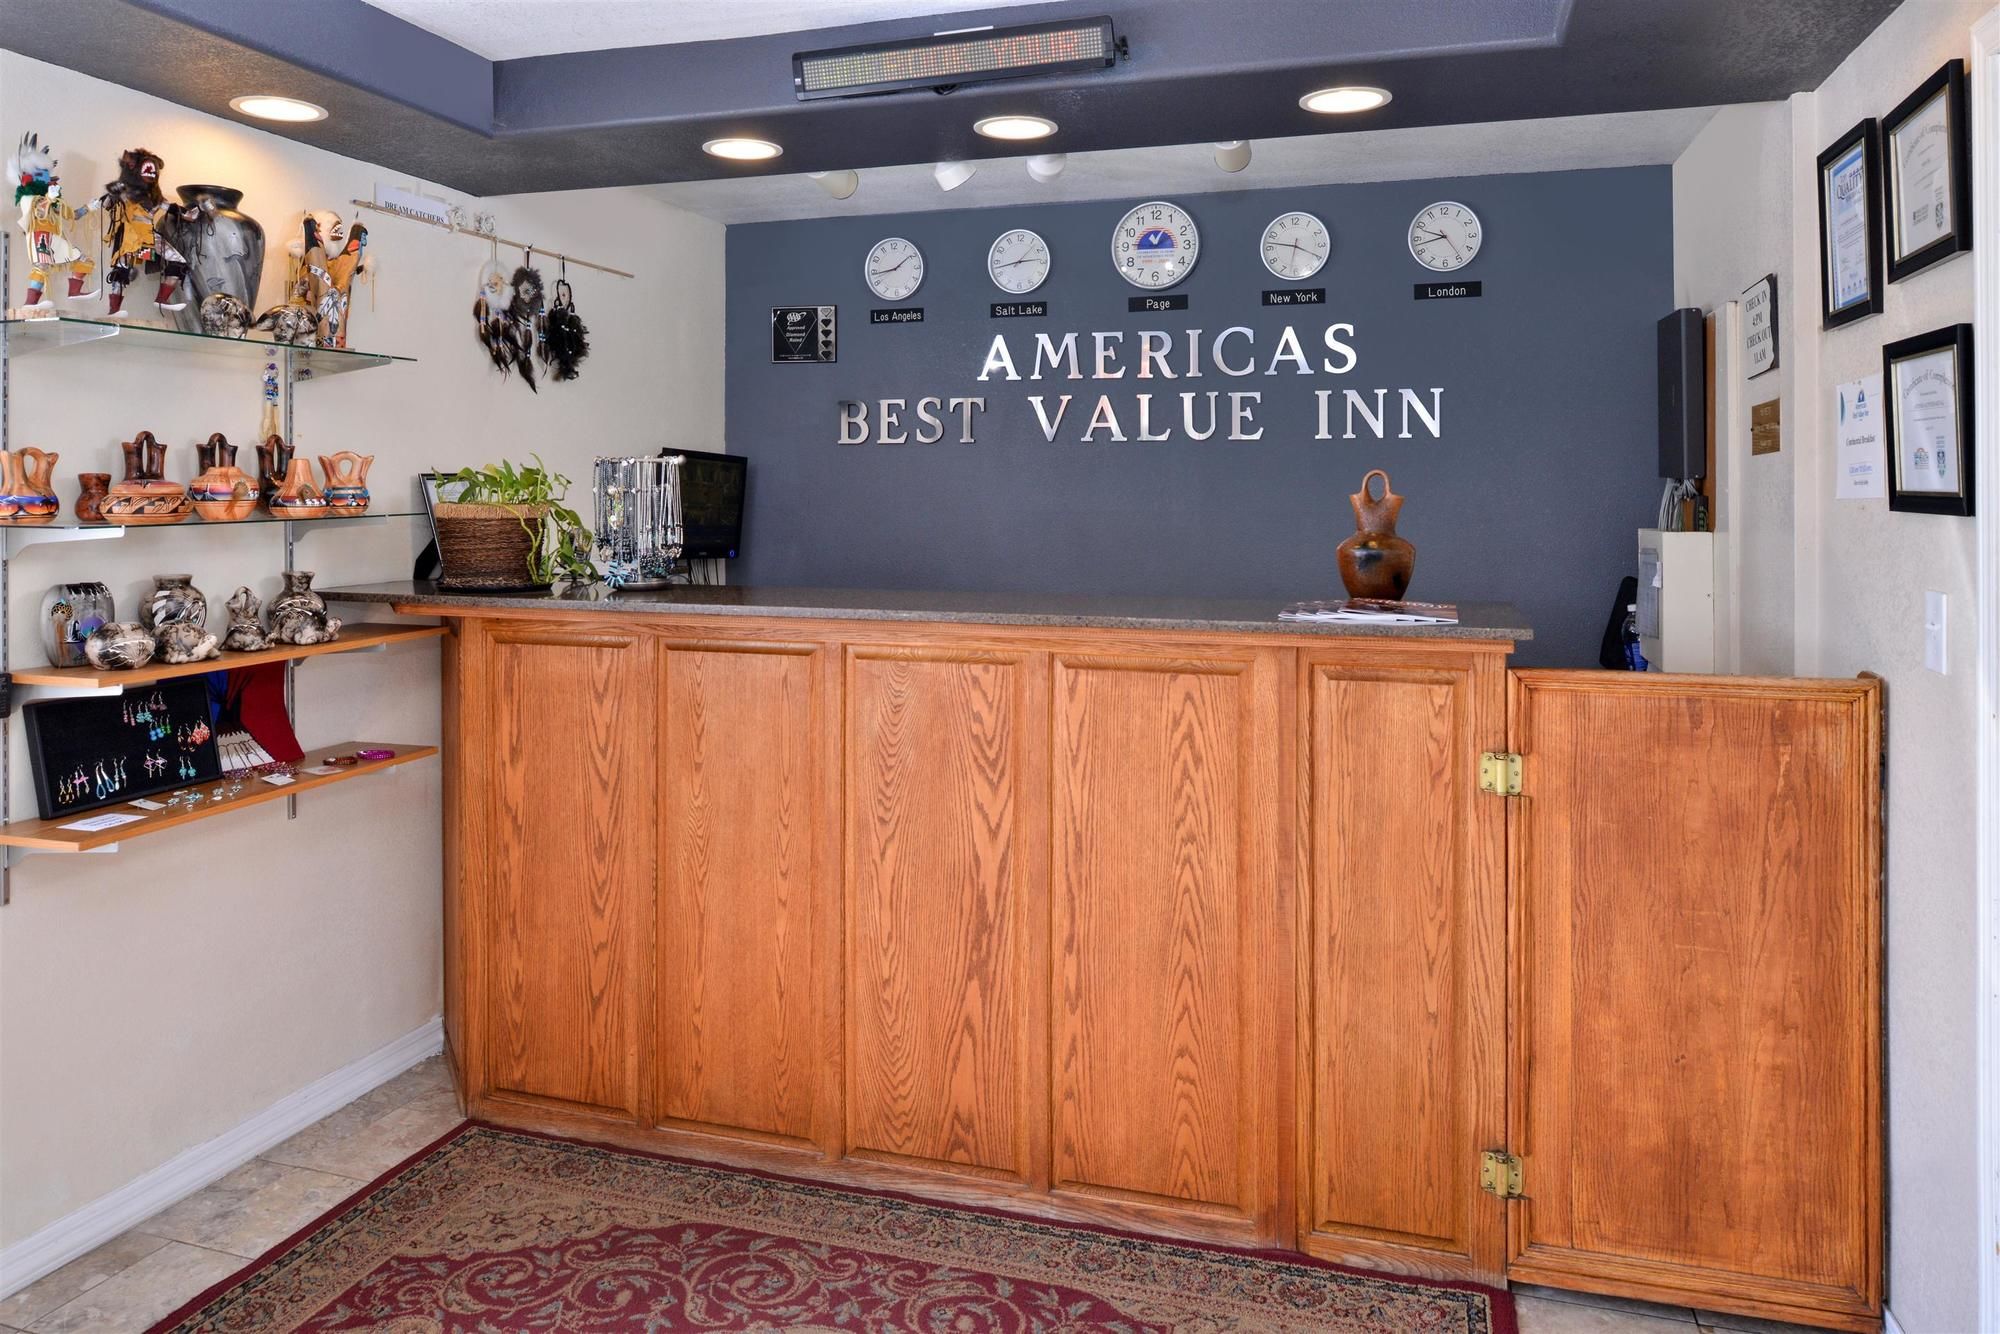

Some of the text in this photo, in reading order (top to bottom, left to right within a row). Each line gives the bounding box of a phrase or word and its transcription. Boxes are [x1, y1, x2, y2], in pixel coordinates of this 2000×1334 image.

[988, 30, 1080, 67] YOUR
[1151, 209, 1162, 220] 12
[1427, 211, 1435, 220] 11
[1440, 207, 1449, 216] 12
[1136, 216, 1145, 225] 11
[1168, 214, 1173, 224] 1
[1291, 217, 1300, 226] 12
[1463, 218, 1473, 227] 2
[1279, 221, 1287, 230] 11
[1416, 221, 1426, 229] 10
[1125, 228, 1136, 238] 10
[1180, 225, 1188, 236] 2
[1268, 231, 1278, 240] 10
[1313, 229, 1322, 237] 2
[1017, 234, 1025, 242] 12
[890, 242, 898, 250] 12
[1121, 241, 1130, 252] 9
[1183, 239, 1192, 250] 3
[996, 246, 1005, 255] 10
[1417, 248, 1426, 256] 8
[1126, 257, 1135, 267] 8
[1178, 256, 1186, 266] 4
[1269, 257, 1278, 265] 8
[1427, 255, 1436, 265] 7
[1442, 258, 1449, 268] 6
[1455, 254, 1463, 263] 5
[1137, 268, 1145, 278] 7
[1151, 271, 1160, 282] 6
[1428, 285, 1466, 297] London
[1270, 292, 1318, 304] New York
[1745, 289, 1767, 313] CHECK IN
[995, 304, 1043, 316] Salt Lake
[1146, 299, 1170, 311] Page
[874, 311, 922, 323] Los Angeles
[1747, 325, 1770, 350] CHECK OUT
[977, 323, 1357, 381] AMERICAS
[837, 388, 1444, 445] BEST VALUE INN
